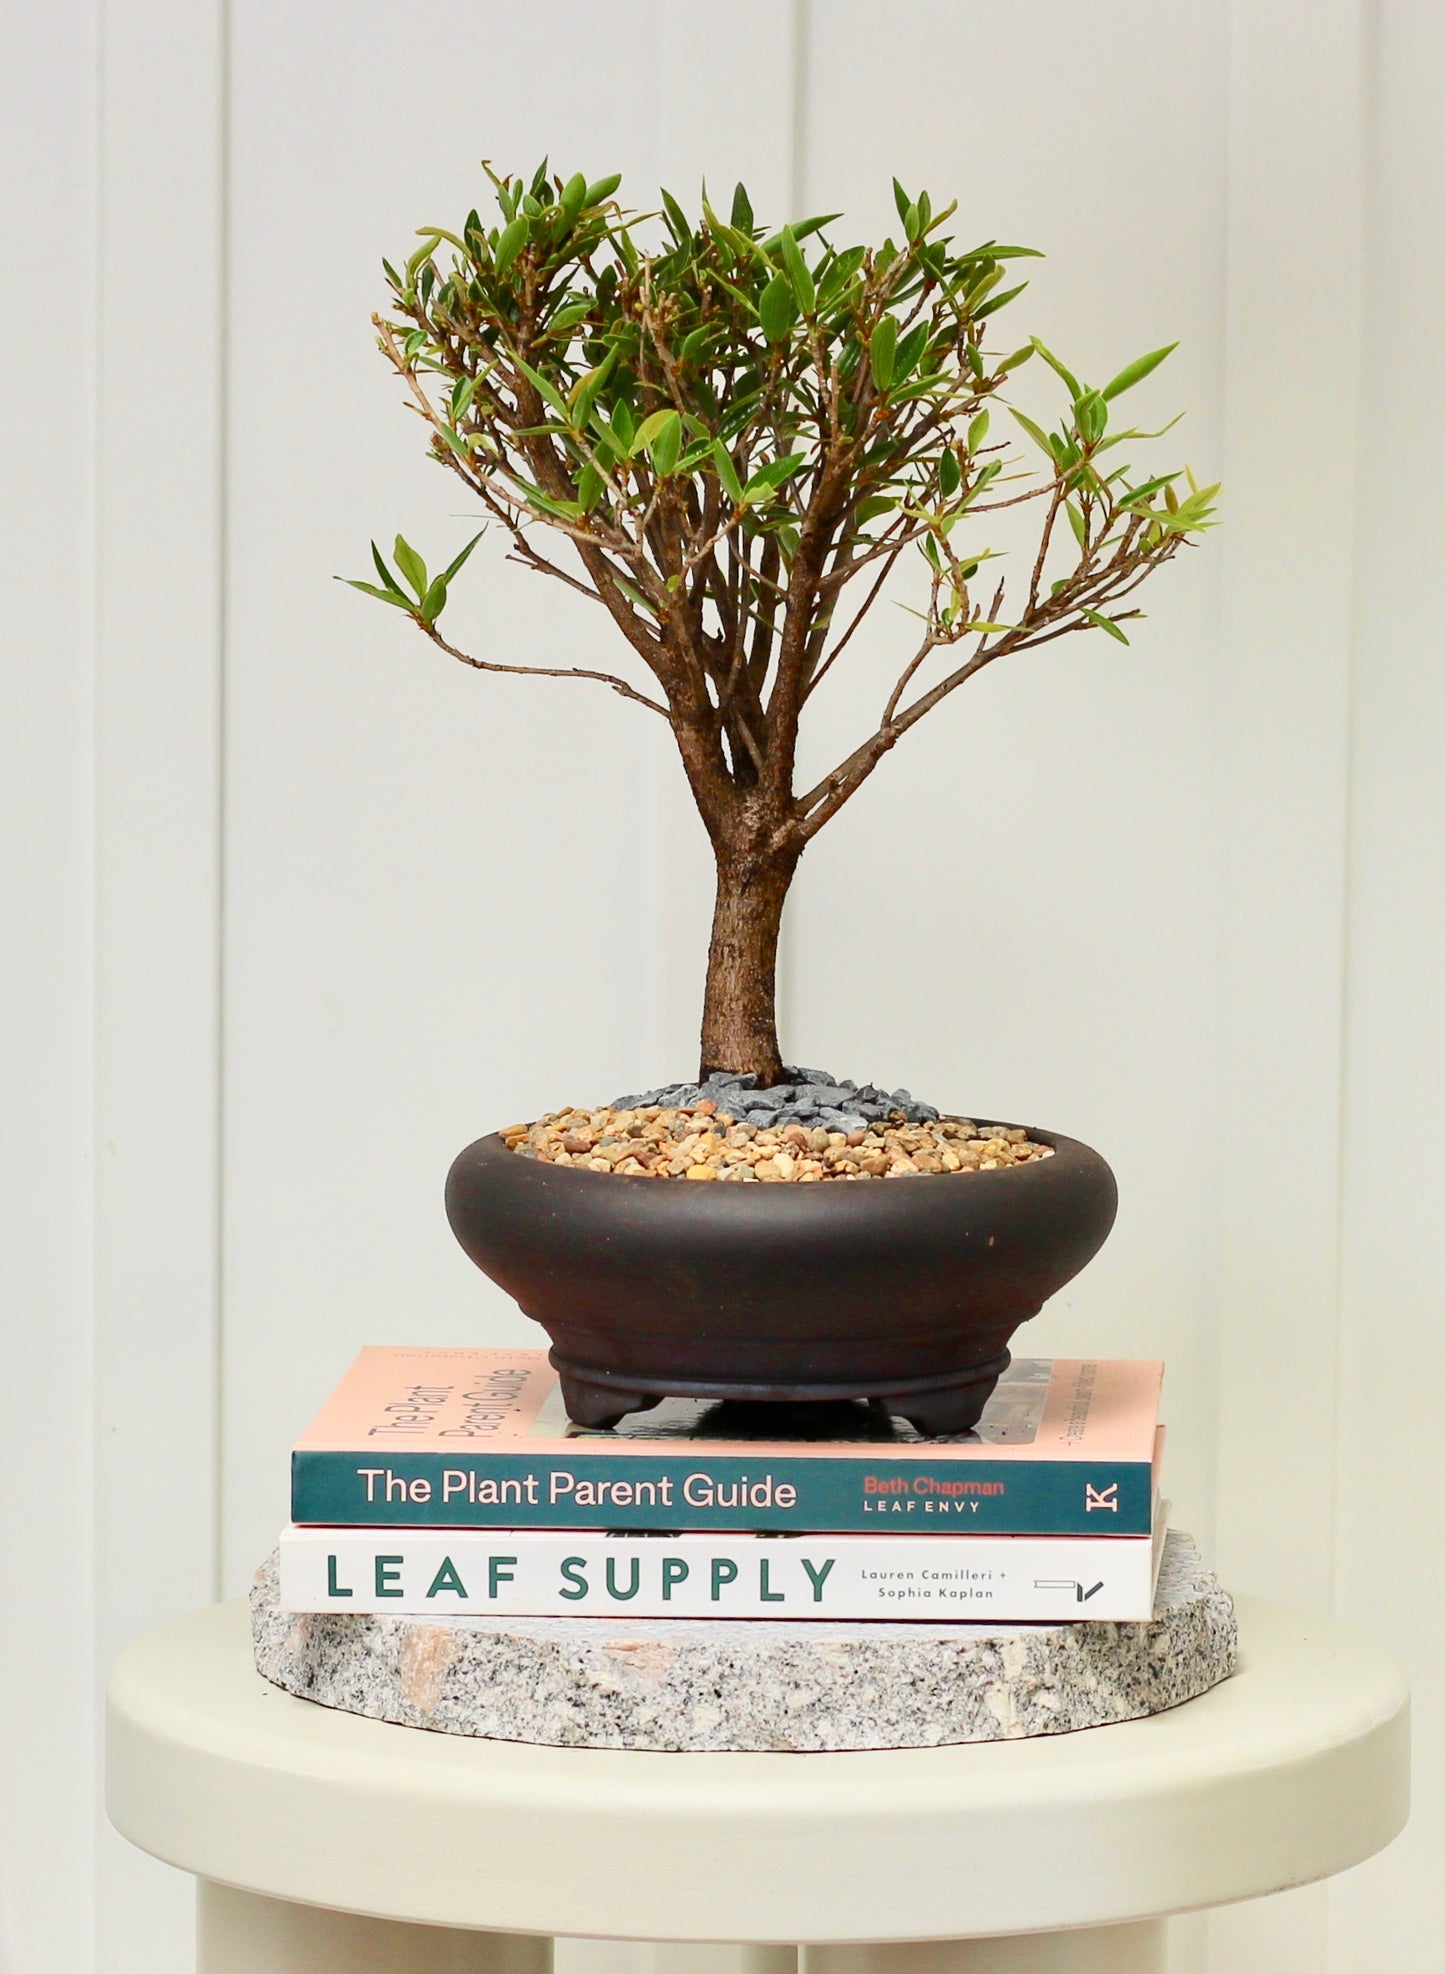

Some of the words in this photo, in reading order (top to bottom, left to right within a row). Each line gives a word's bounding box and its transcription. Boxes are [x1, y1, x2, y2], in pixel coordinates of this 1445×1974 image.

[462, 1368, 532, 1401] Guide
[384, 1385, 454, 1413] Plant
[368, 1415, 435, 1436] The
[439, 1402, 513, 1437] Parent
[357, 1469, 432, 1502] The
[443, 1470, 539, 1504] Plant
[549, 1471, 674, 1507] Parent
[683, 1473, 798, 1508] Guide
[864, 1476, 908, 1495] Beth
[913, 1477, 1005, 1497] Chapman
[1086, 1482, 1118, 1513] K
[864, 1501, 916, 1512] LEAF
[925, 1501, 980, 1513] ENVY
[327, 1555, 518, 1599] LEAF
[558, 1556, 836, 1602] SUPPLY
[861, 1569, 914, 1580] Lauren
[921, 1569, 993, 1581] Camilleri
[878, 1587, 931, 1601] Sophia
[939, 1588, 993, 1601] Kaplan
